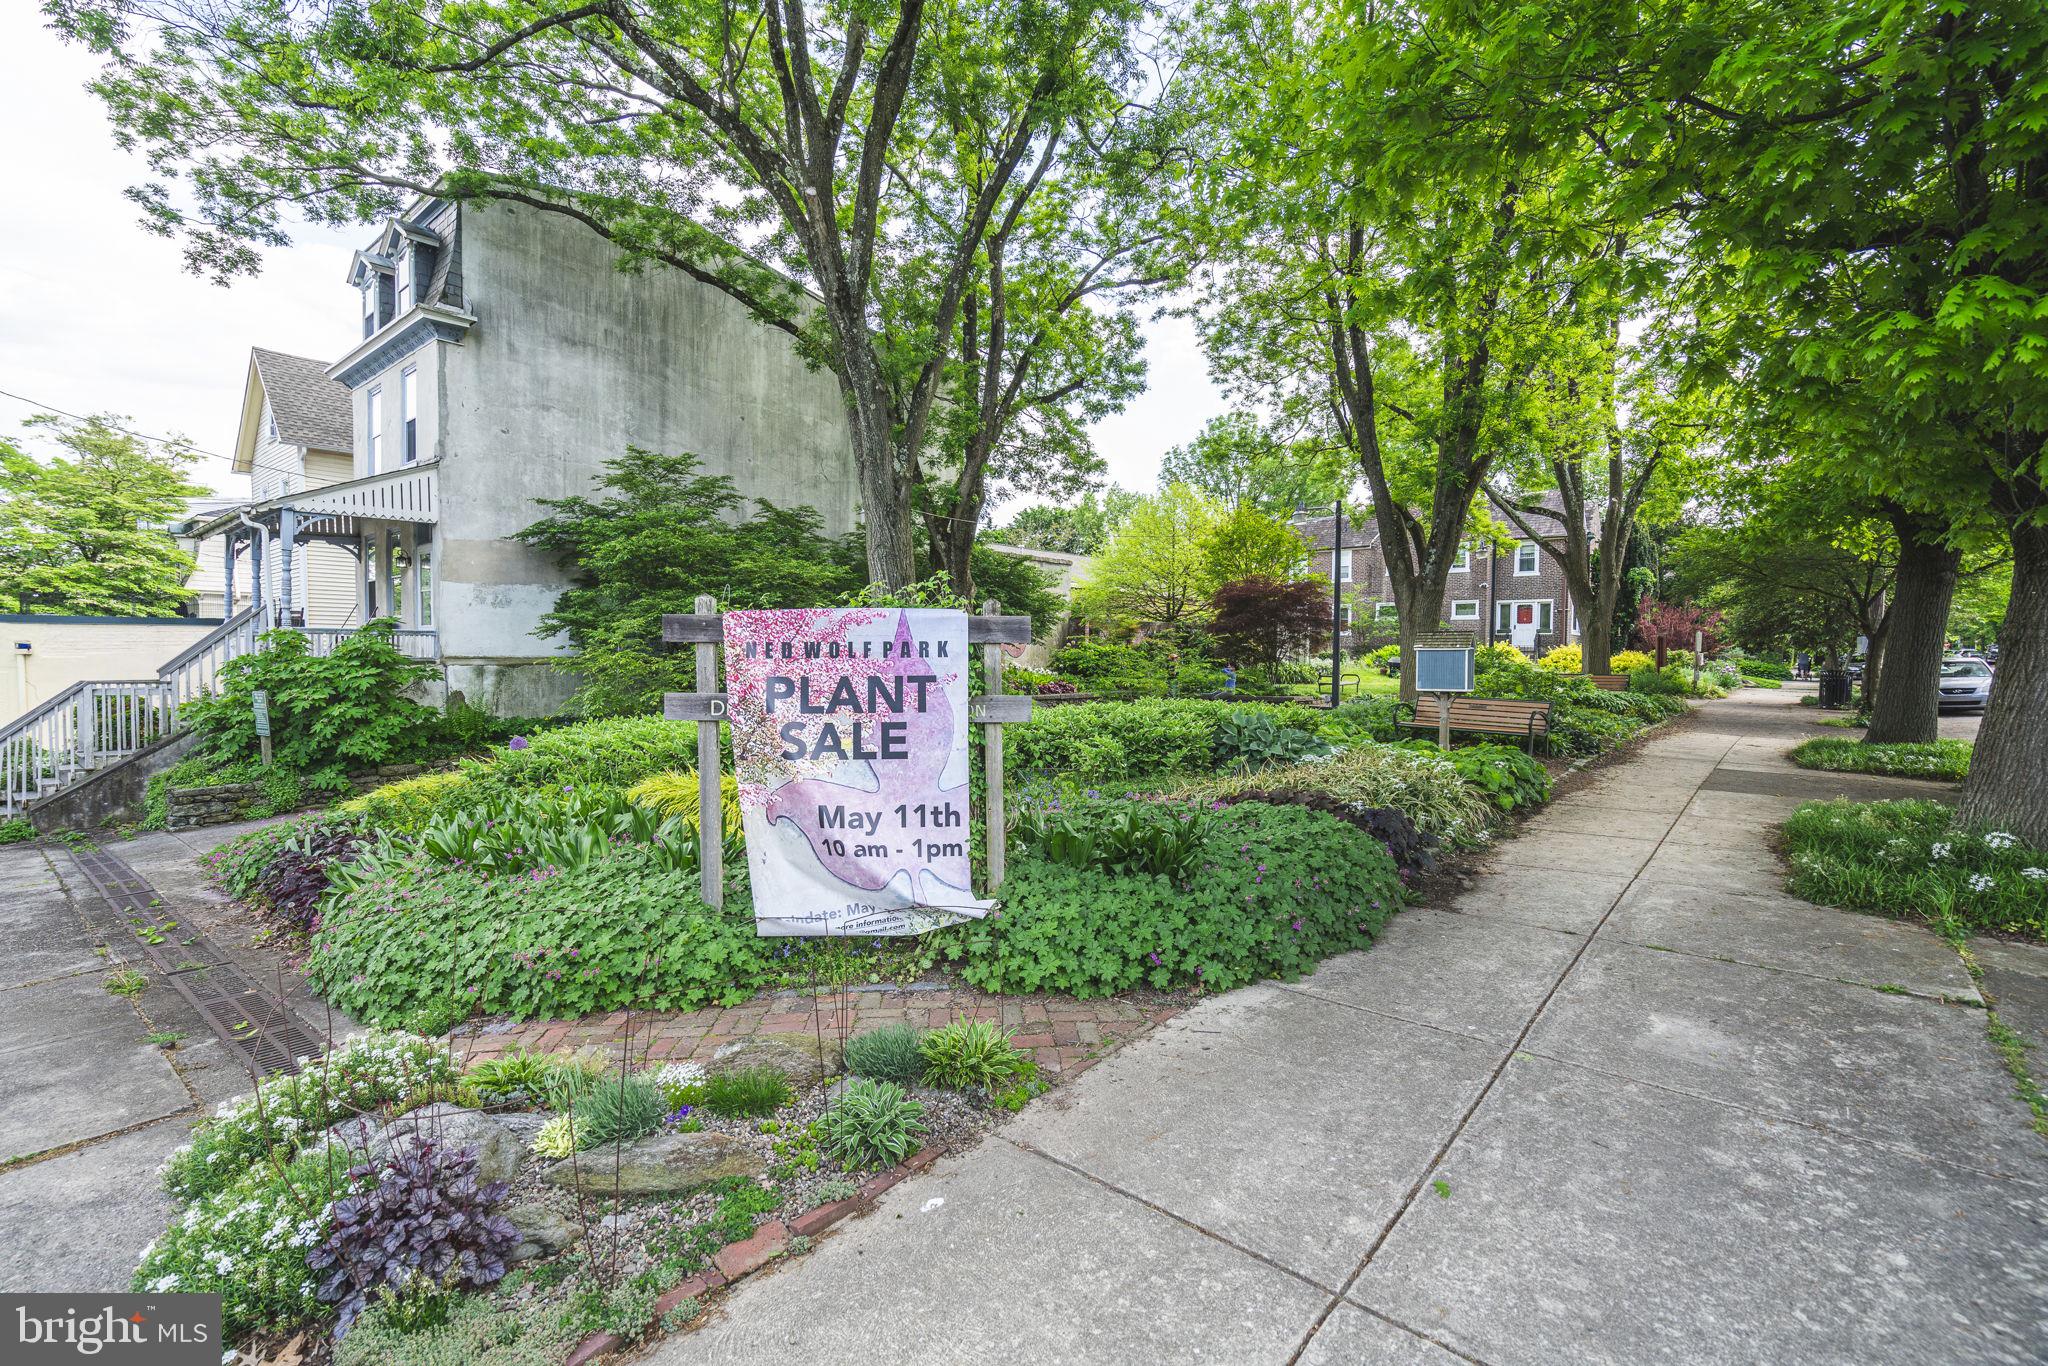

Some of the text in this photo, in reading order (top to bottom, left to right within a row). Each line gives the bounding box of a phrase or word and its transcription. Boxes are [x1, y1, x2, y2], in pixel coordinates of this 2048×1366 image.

[745, 640, 949, 659] NED WOLF PARK
[766, 675, 937, 714] PLANT
[780, 721, 909, 761] SALE
[818, 802, 961, 836] May 11th
[822, 838, 846, 857] 10
[853, 844, 888, 858] am
[912, 838, 963, 863] 1pm
[846, 902, 876, 917] May
